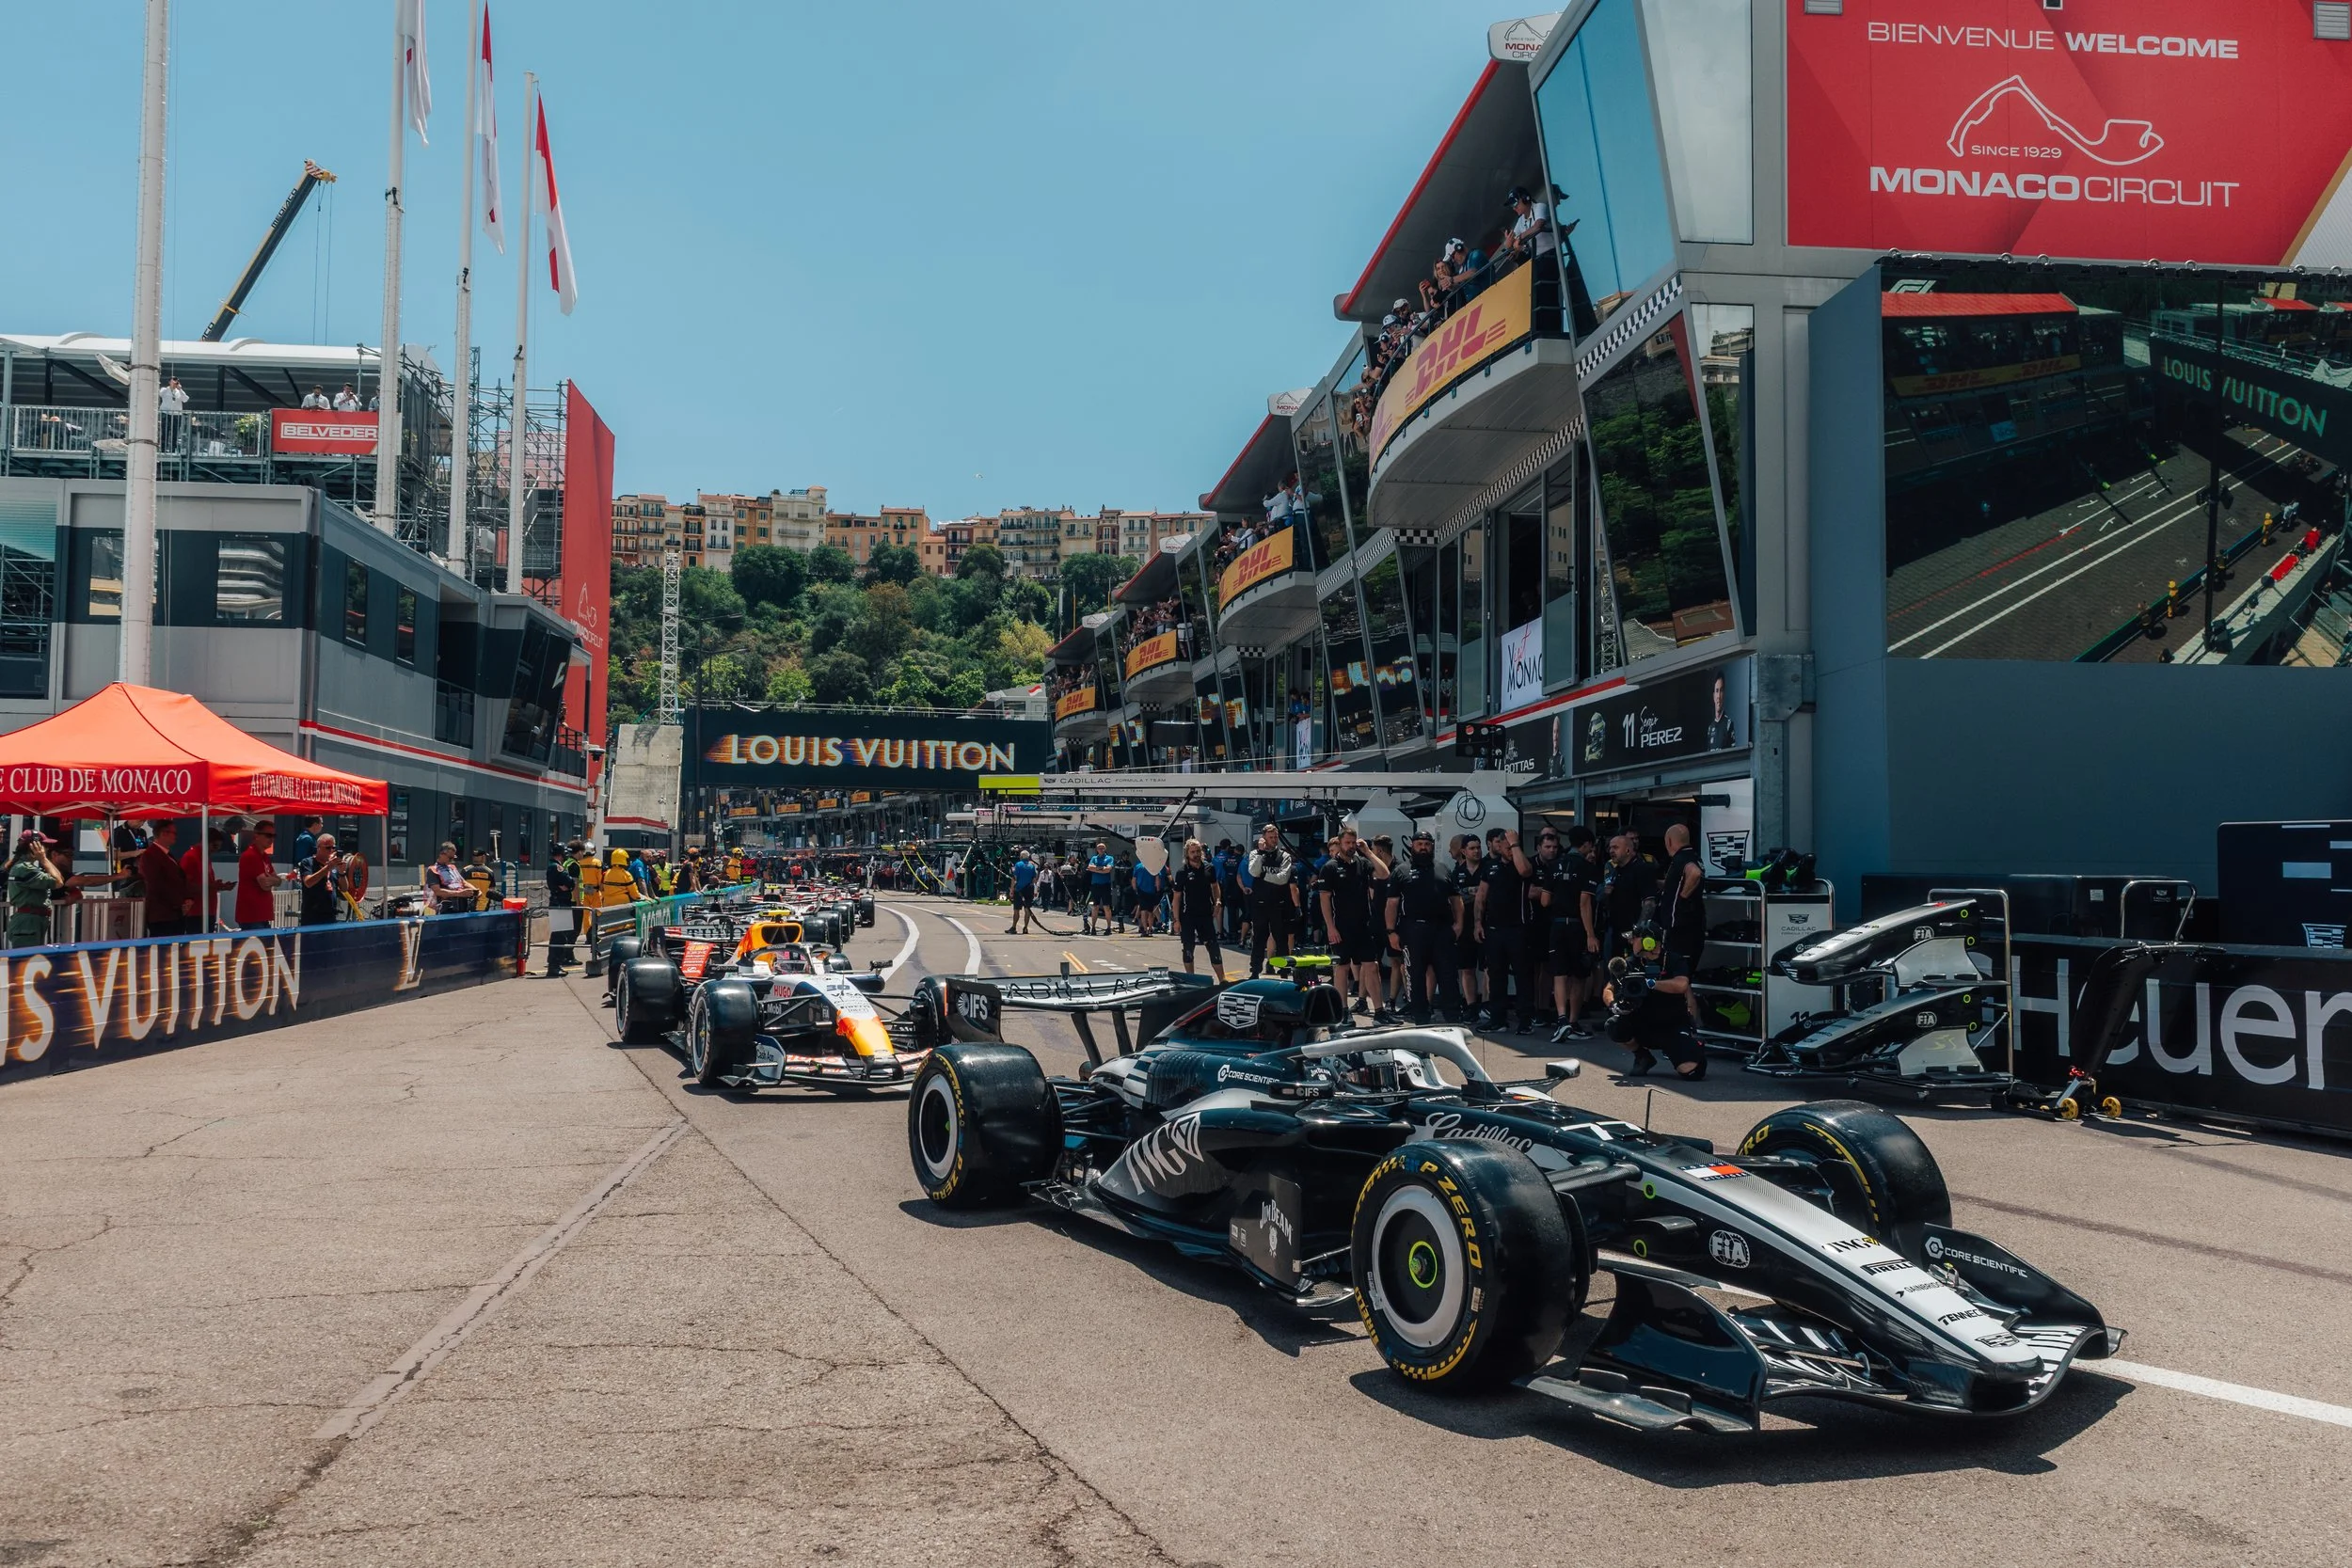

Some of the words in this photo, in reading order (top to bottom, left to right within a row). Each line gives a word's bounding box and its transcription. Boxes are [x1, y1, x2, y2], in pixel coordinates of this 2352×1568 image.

[1867, 22, 2055, 51] BIENVENUE
[2065, 32, 2239, 59] WELCOME
[1971, 144, 2020, 157] SINCE
[2023, 146, 2062, 158] 1929
[1407, 304, 1498, 406] DHL
[2165, 356, 2211, 391] LOUIS
[1235, 543, 1277, 588] DHL
[1137, 640, 1167, 668] DHL
[1064, 693, 1087, 713] DHL
[1622, 713, 1636, 749] 11
[1640, 726, 1682, 749] PEREZ
[731, 734, 843, 767] LOUIS
[856, 737, 1015, 771] VUITTON
[9, 768, 64, 794] CLUB
[69, 768, 97, 793] DE
[101, 768, 192, 795] MONACO
[250, 772, 301, 800] AUTOMOBILE
[301, 778, 321, 801] CLUB
[322, 781, 331, 802] DE
[331, 782, 361, 806] MONACO
[77, 931, 301, 1050] VUITTON
[773, 984, 791, 998] HUGO
[1006, 976, 1157, 1001] ADILLAC
[767, 1002, 782, 1015] Mobil
[969, 991, 988, 1021] IFS
[1789, 1011, 1810, 1024] 11
[1228, 1071, 1245, 1080] CORE
[1305, 1088, 1320, 1097] IFS
[1260, 1201, 1272, 1229] JIM
[1272, 1198, 1293, 1246] BEAM
[1420, 1161, 1438, 1174] P
[1438, 1176, 1483, 1269] ZERO
[1944, 1247, 1972, 1263] CORE
[1972, 1255, 2028, 1279] SCIENTIFIC
